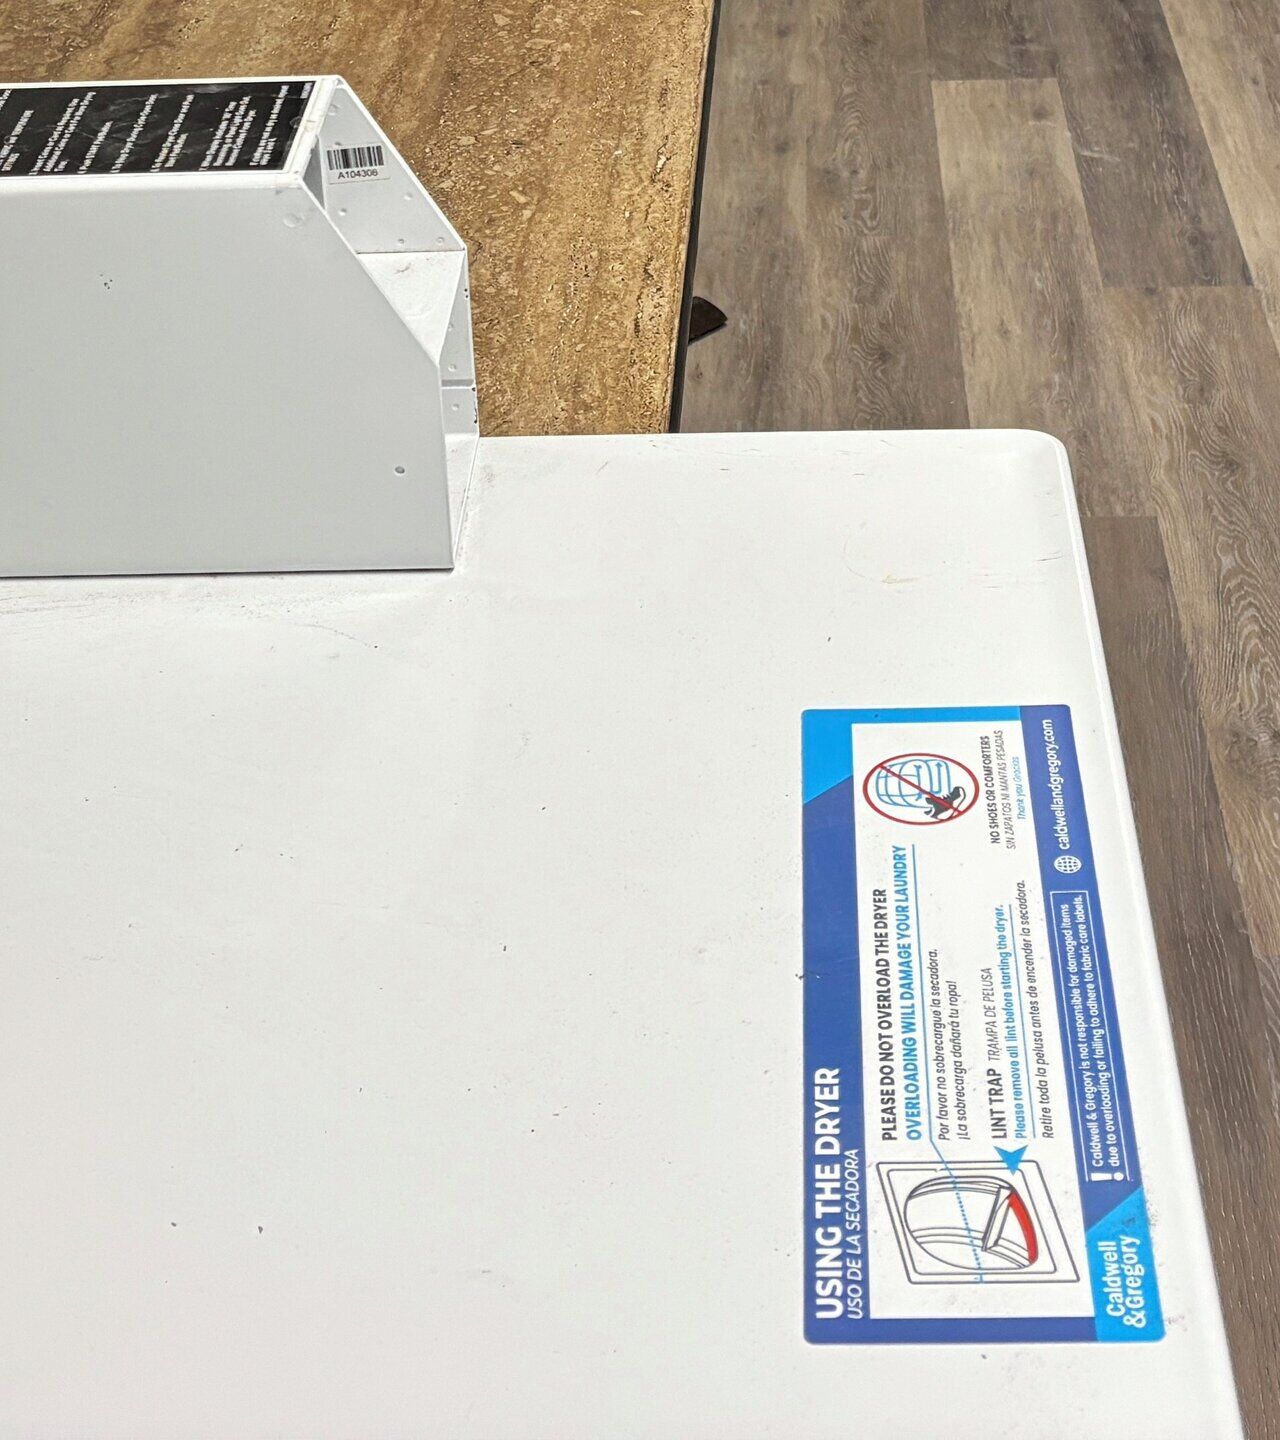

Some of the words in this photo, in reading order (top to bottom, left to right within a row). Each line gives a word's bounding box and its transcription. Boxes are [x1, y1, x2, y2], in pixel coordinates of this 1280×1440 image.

[980, 736, 994, 788] COMFORTERS
[986, 790, 995, 801] OR
[1042, 720, 1070, 849] caldwellandgregory.com
[987, 803, 999, 829] SHOES
[990, 831, 1000, 843] NO
[892, 846, 909, 902] LAUNDRY
[873, 889, 888, 929] DRYER
[1016, 880, 1029, 925] secadora.
[1060, 904, 1071, 928] items
[1073, 895, 1086, 922] labels.
[895, 906, 910, 940] YOUR
[995, 905, 1007, 932] dryer.
[1020, 928, 1031, 936] la
[1077, 924, 1088, 943] care
[874, 932, 889, 955] THE
[996, 935, 1007, 949] the
[1063, 930, 1078, 972] damaged
[897, 943, 914, 1000] DAMAGE
[927, 949, 940, 996] secadora.
[998, 952, 1012, 989] starting
[1021, 939, 1035, 983] encender
[1080, 945, 1092, 970] fabric
[981, 968, 994, 1002] PELUSA
[1026, 986, 1037, 998] de
[1069, 975, 1079, 986] for
[1084, 973, 1093, 981] to
[876, 959, 892, 1030] OVERLOAD
[930, 999, 940, 1007] la
[946, 981, 961, 1006] ropa!
[1001, 992, 1015, 1023] before
[1085, 984, 1098, 1015] adhere
[900, 1003, 915, 1033] WILL
[948, 1009, 959, 1018] tu
[984, 1005, 996, 1017] DE
[1029, 1001, 1042, 1028] antes
[1070, 989, 1087, 1041] responsible
[1090, 1018, 1100, 1027] to
[878, 1033, 894, 1061] NOT
[933, 1011, 946, 1073] sobrecargue
[948, 1021, 962, 1057] dañará
[985, 1021, 1000, 1061] TRAMPA
[1005, 1026, 1017, 1041] lint
[1033, 1031, 1049, 1065] pelusa
[1090, 1030, 1104, 1058] failing
[1007, 1046, 1018, 1058] all
[1077, 1044, 1088, 1059] not
[1097, 1061, 1106, 1069] or
[879, 1065, 894, 1085] DO
[936, 1077, 946, 1089] no
[987, 1069, 1004, 1105] TRAP
[1011, 1061, 1023, 1100] remove
[1035, 1068, 1047, 1077] la
[902, 1038, 921, 1140] OVERLOADING
[953, 1061, 967, 1121] sobrecarga
[1037, 1081, 1050, 1104] toda
[1082, 1071, 1097, 1110] Gregory
[1097, 1072, 1115, 1131] overloading
[814, 1068, 840, 1155] DRYER
[880, 1089, 897, 1141] PLEASE
[936, 1093, 948, 1120] favor
[1014, 1104, 1026, 1138] Please
[938, 1123, 949, 1140] Por
[989, 1109, 1007, 1138] LINT
[1040, 1108, 1054, 1138] Retire
[1087, 1123, 1103, 1167] Caldwell
[1106, 1134, 1116, 1144] to
[1108, 1147, 1119, 1166] due
[815, 1164, 841, 1219] THE
[844, 1149, 860, 1230] SECADORA
[846, 1235, 861, 1254] LA
[815, 1227, 843, 1318] USING
[847, 1259, 862, 1280] DE
[1097, 1241, 1125, 1316] Caldwell
[1119, 1235, 1146, 1328] &Gregory
[847, 1285, 863, 1319] USO
